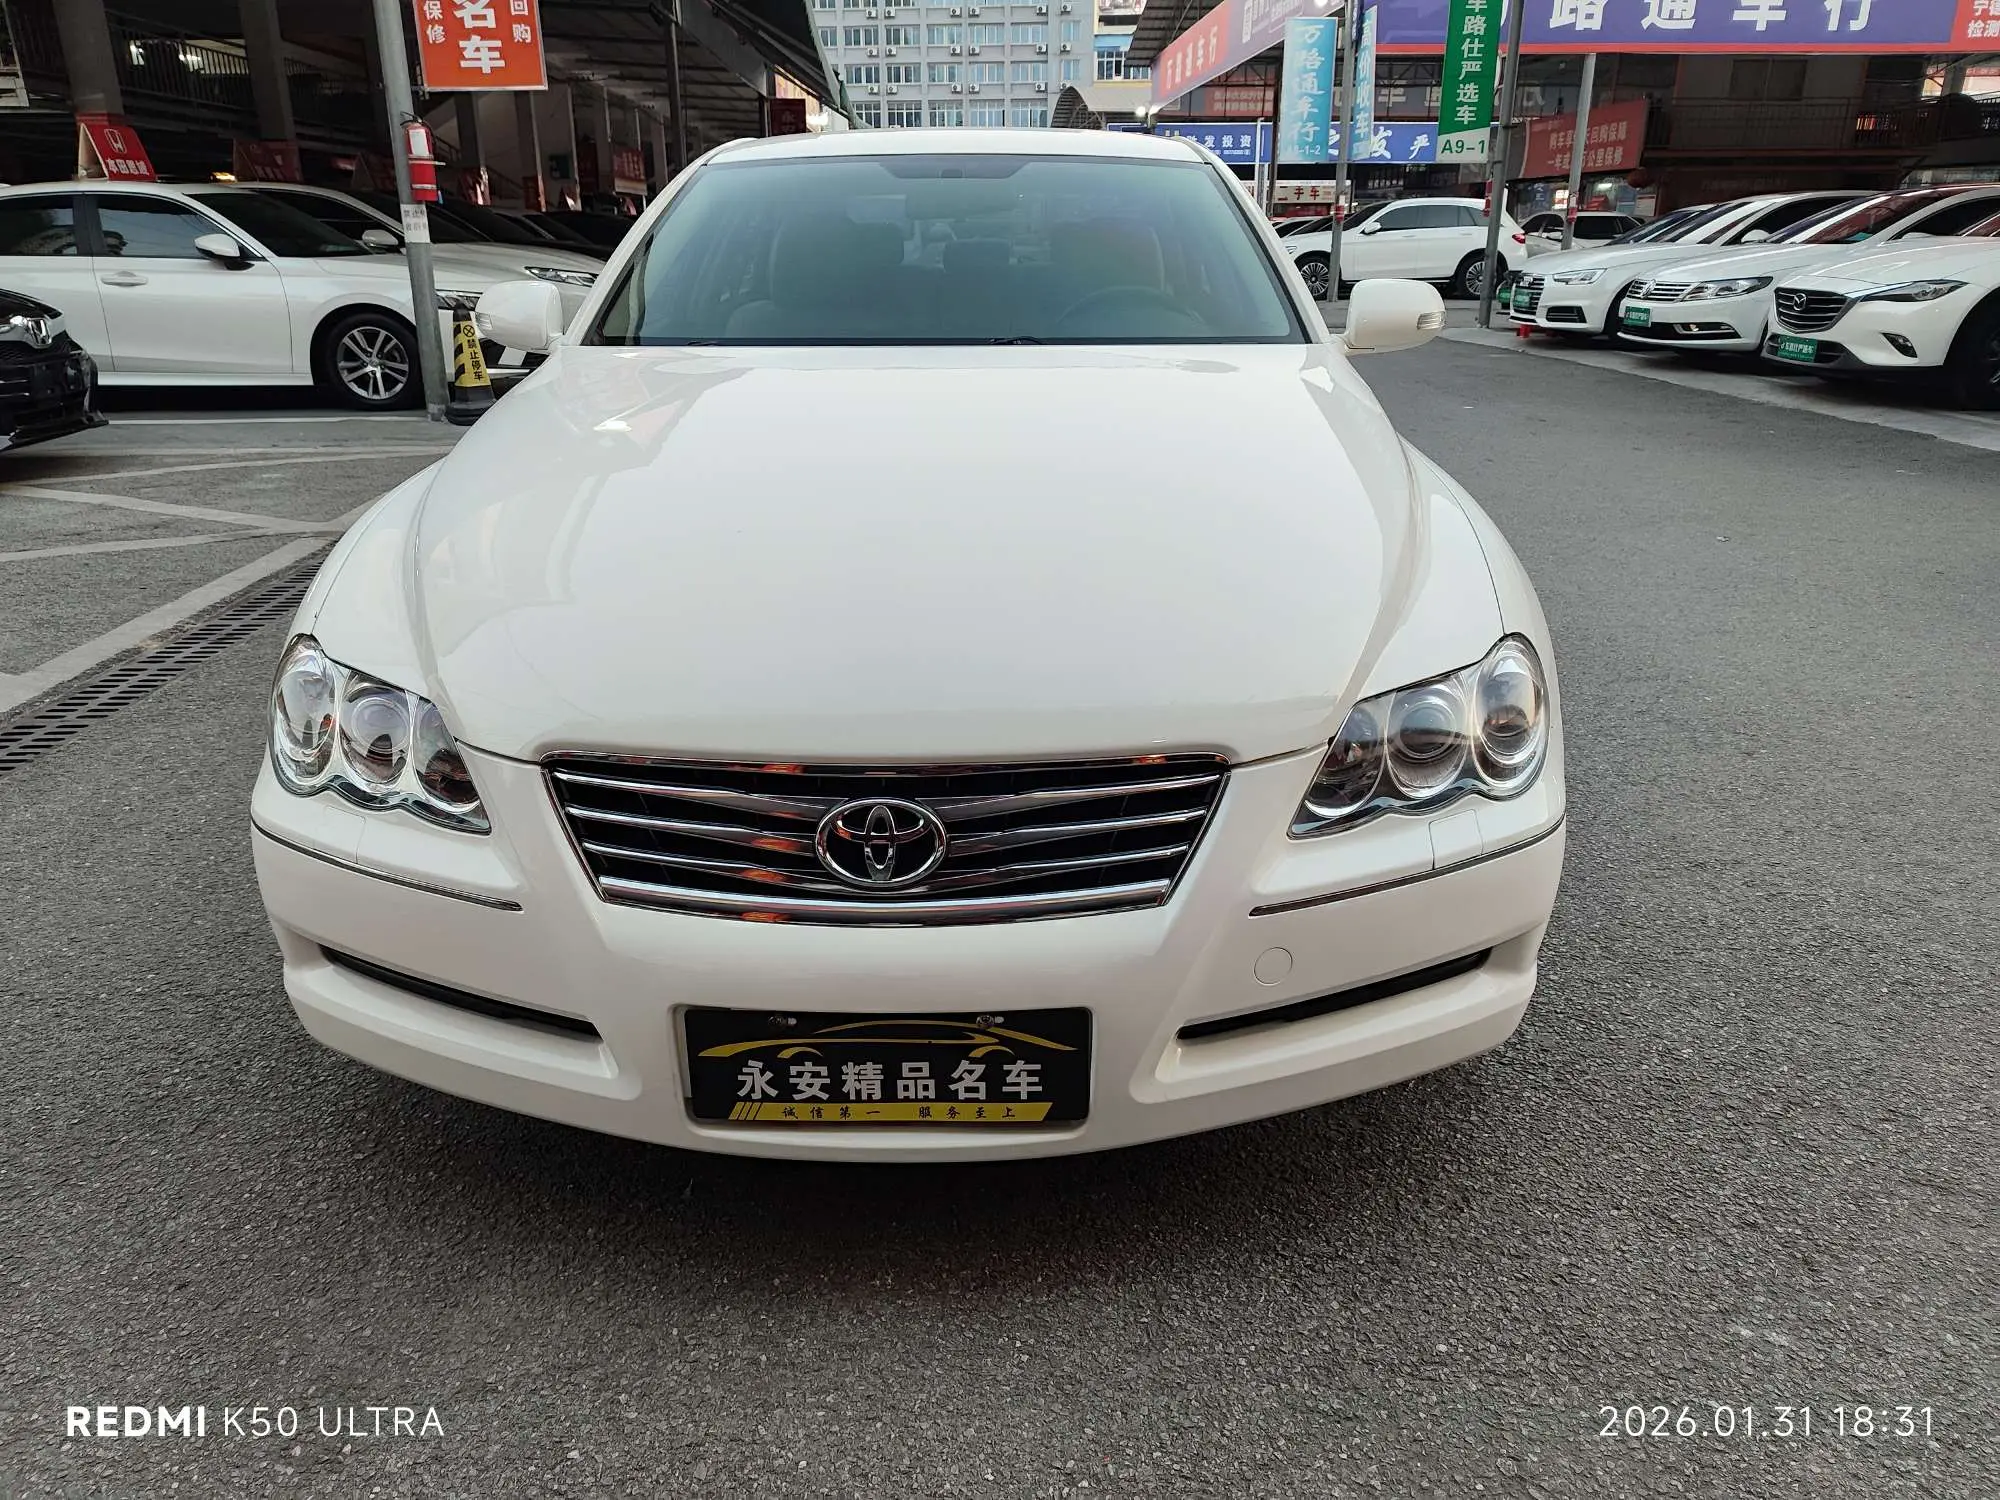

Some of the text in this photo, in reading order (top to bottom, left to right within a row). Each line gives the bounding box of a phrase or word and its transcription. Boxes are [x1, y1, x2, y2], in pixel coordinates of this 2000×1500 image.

[423, 0, 446, 44] 保修
[509, 0, 532, 43] 回购
[1500, 0, 1877, 31] 路通车行
[453, 0, 506, 74] 名车
[1288, 24, 1325, 142] 万路通车行
[1441, 139, 1486, 154] A9-1
[467, 340, 484, 381] 禁止停车
[737, 1059, 1043, 1100] 永安精品名车
[783, 1106, 1016, 1120] 诚信第一 服务至上
